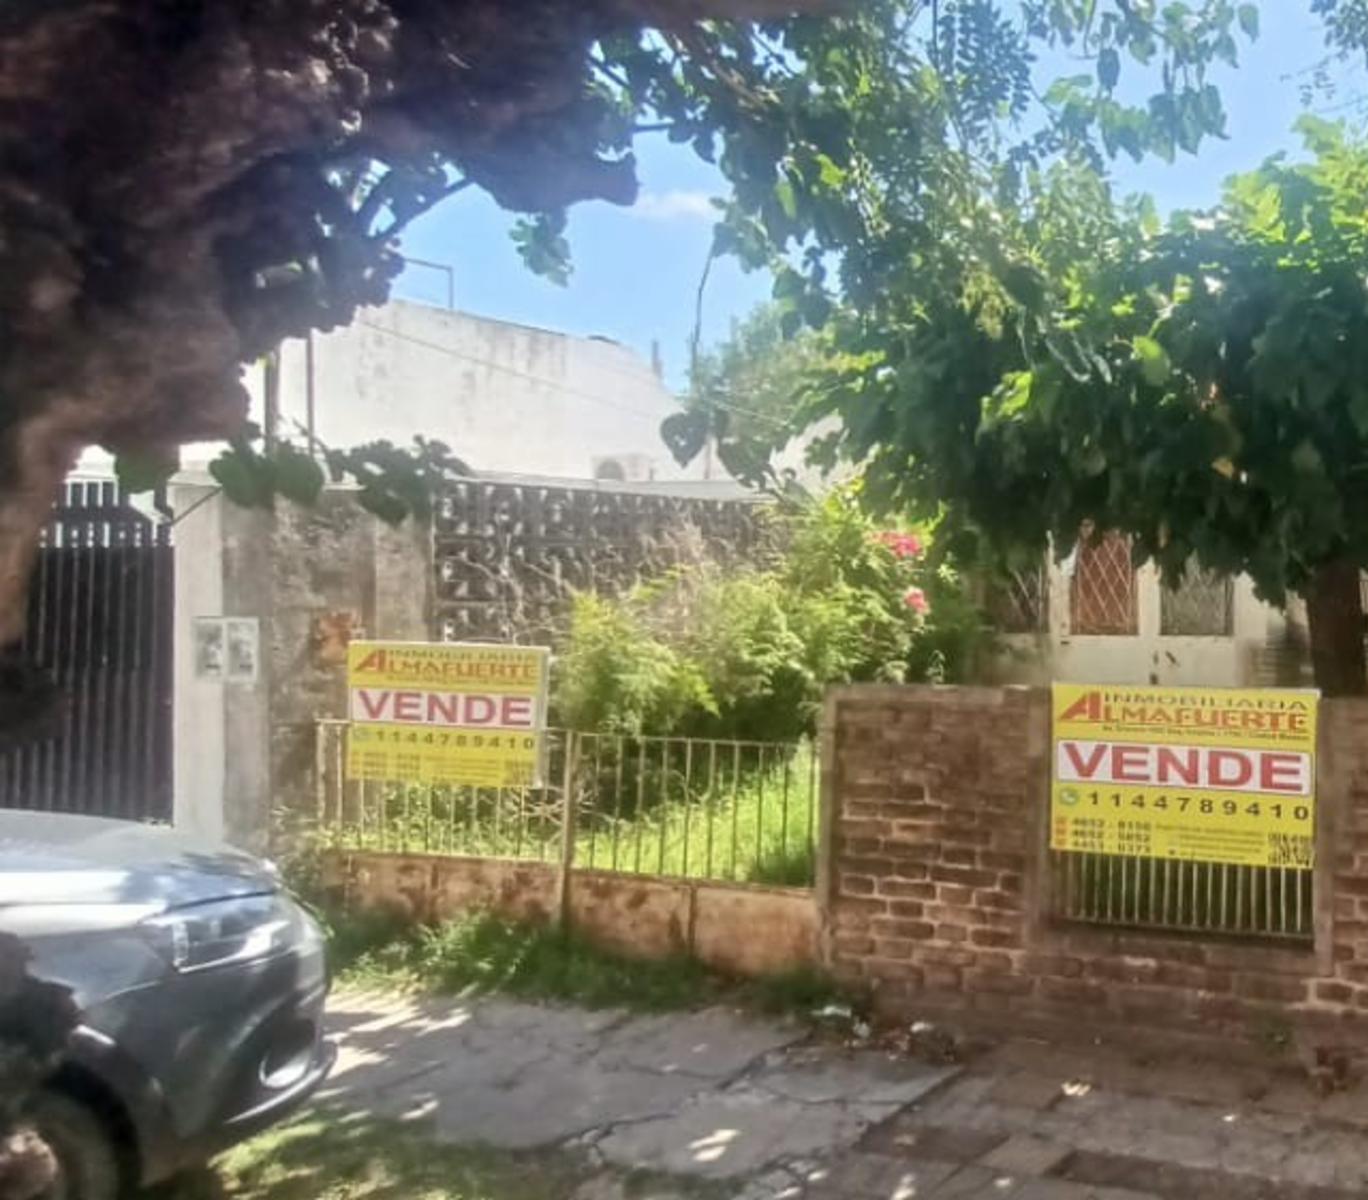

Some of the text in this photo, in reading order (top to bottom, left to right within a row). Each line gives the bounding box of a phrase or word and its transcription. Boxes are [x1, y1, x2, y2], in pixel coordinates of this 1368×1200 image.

[354, 649, 536, 679] ALMAFUERTE
[358, 690, 532, 726] VENDE
[1058, 691, 1310, 732] ALMAFUERTE
[1104, 693, 1308, 711] INMOBILIARIA
[376, 730, 535, 749] 1144789410
[1063, 742, 1303, 791] VENDE
[1088, 791, 1310, 821] 1144789410
